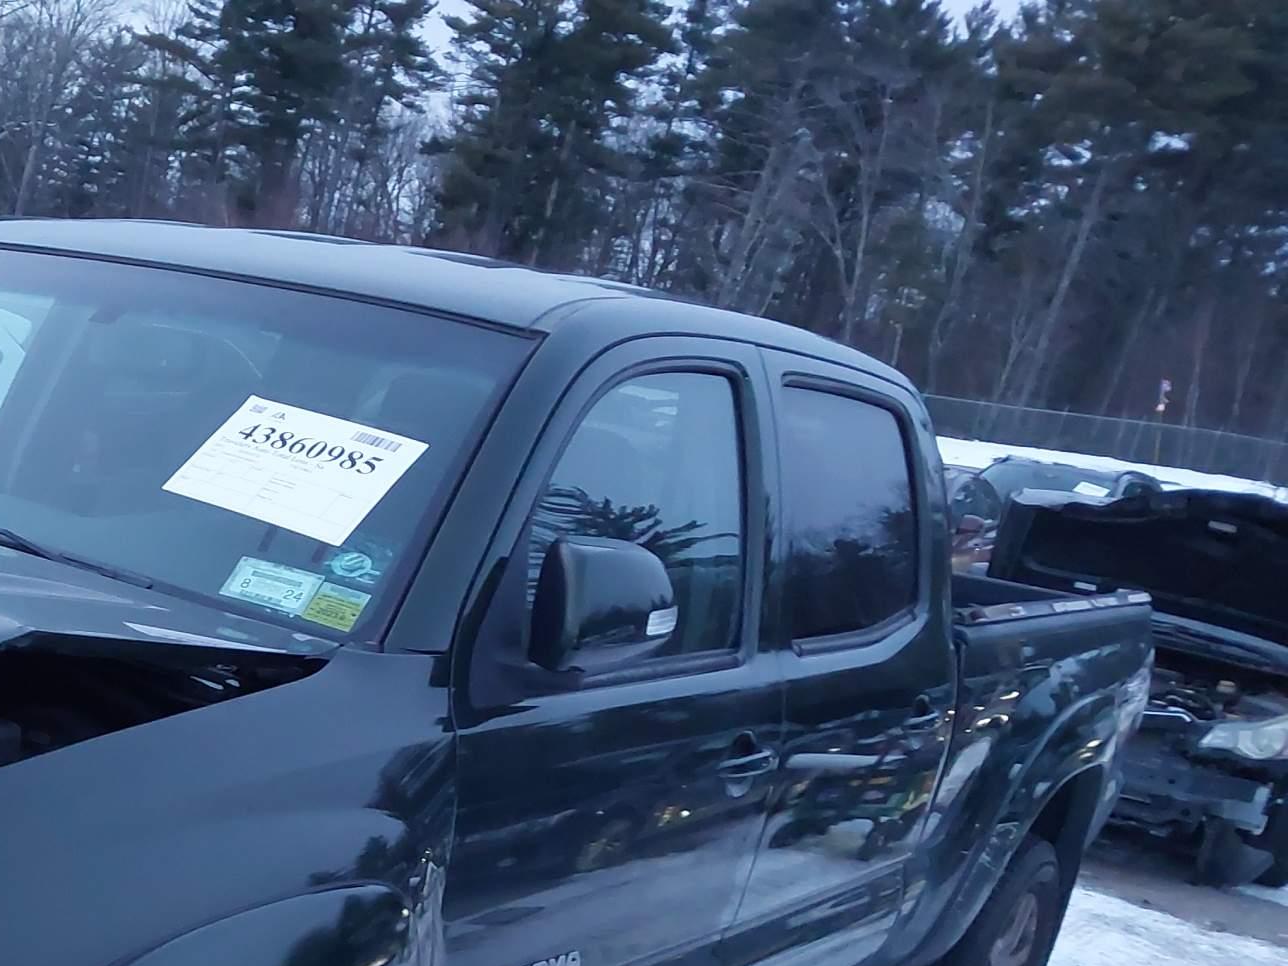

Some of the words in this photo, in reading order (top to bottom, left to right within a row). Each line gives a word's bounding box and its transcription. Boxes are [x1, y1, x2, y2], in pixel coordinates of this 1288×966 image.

[238, 423, 384, 475] 43860985
[240, 578, 252, 589] 8
[282, 589, 305, 603] 24
